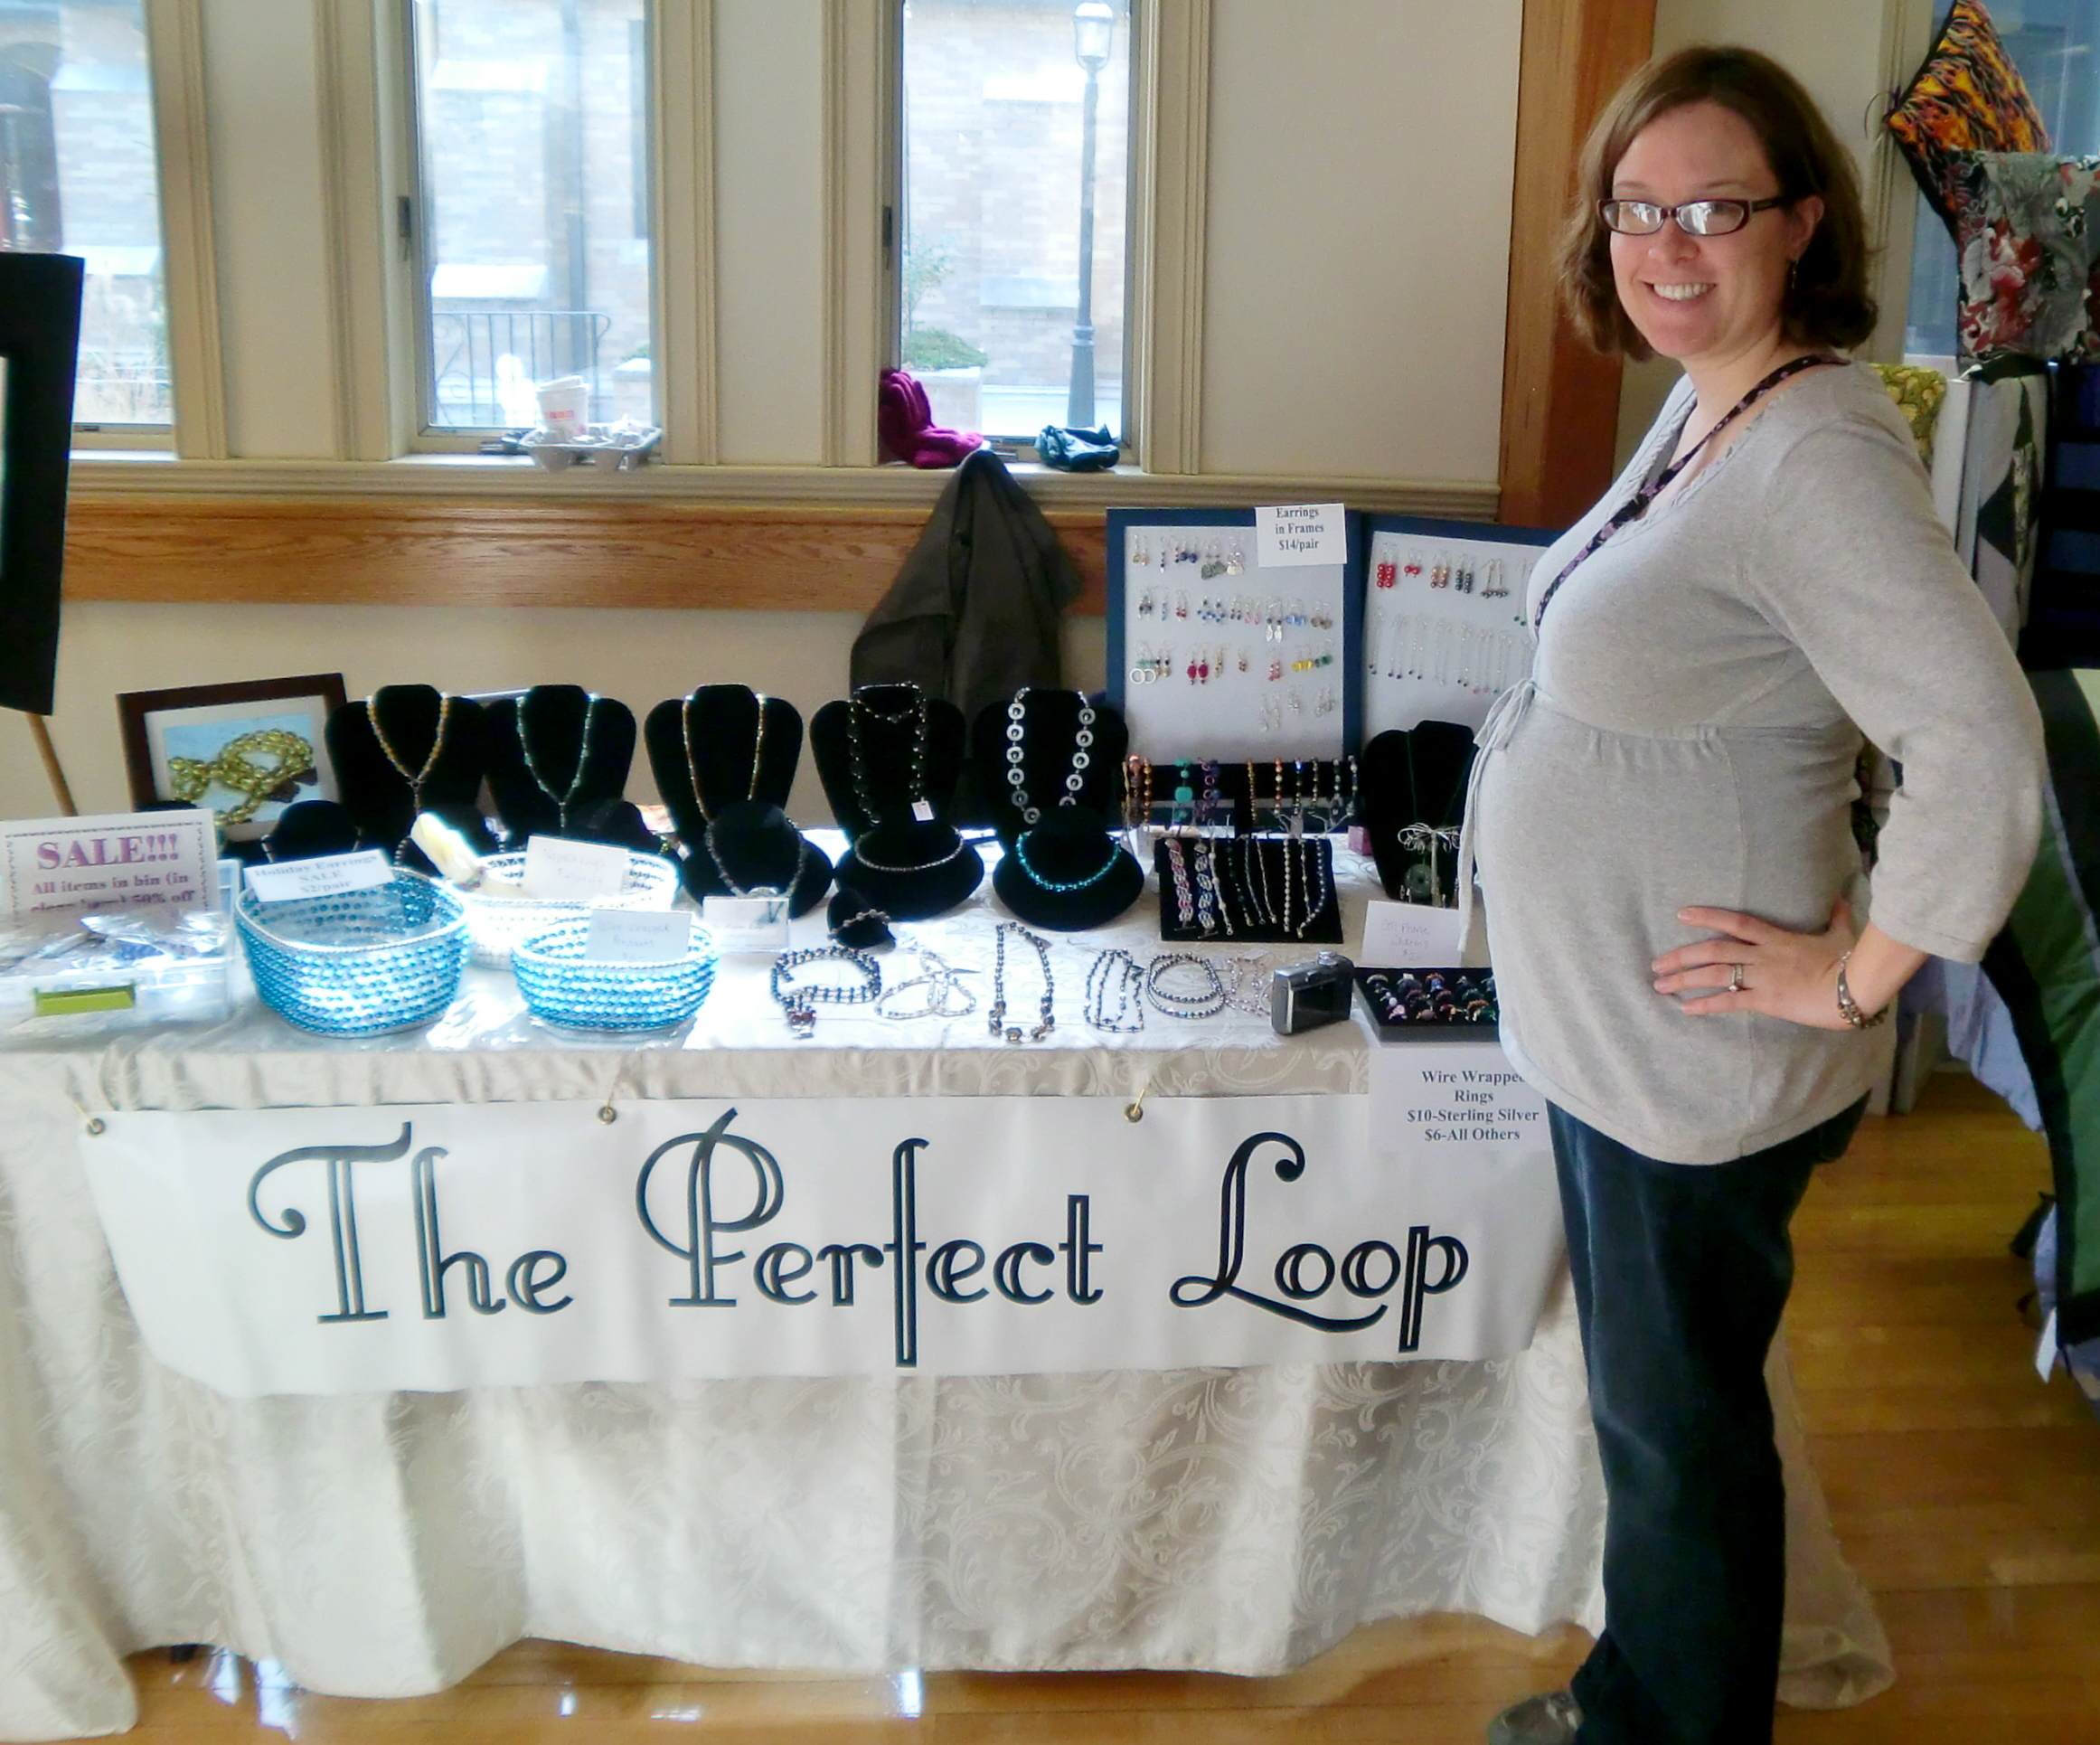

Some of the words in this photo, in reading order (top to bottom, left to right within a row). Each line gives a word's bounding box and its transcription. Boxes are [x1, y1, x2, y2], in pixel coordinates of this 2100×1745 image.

[1276, 507, 1319, 519] Earrings
[1276, 524, 1285, 534] in
[1288, 523, 1324, 533] Frames
[1278, 539, 1319, 552] $14/pair
[36, 832, 180, 871] SALE!!!
[315, 854, 378, 871] Earrings
[32, 881, 56, 895] All
[60, 881, 107, 892] items
[112, 877, 128, 888] in
[135, 873, 161, 887] bin
[166, 871, 189, 885] (in
[170, 889, 196, 903] off
[1421, 1070, 1457, 1084] Wire
[1454, 1089, 1494, 1105] Rings
[1407, 1108, 1494, 1125] $10-Sterling
[1497, 1108, 1540, 1122] Silver
[1424, 1128, 1468, 1142] $6-All
[1472, 1127, 1521, 1141] Others
[246, 1120, 574, 1325] The
[635, 1107, 1104, 1368] Perfect
[1169, 1130, 1470, 1354] Loop
